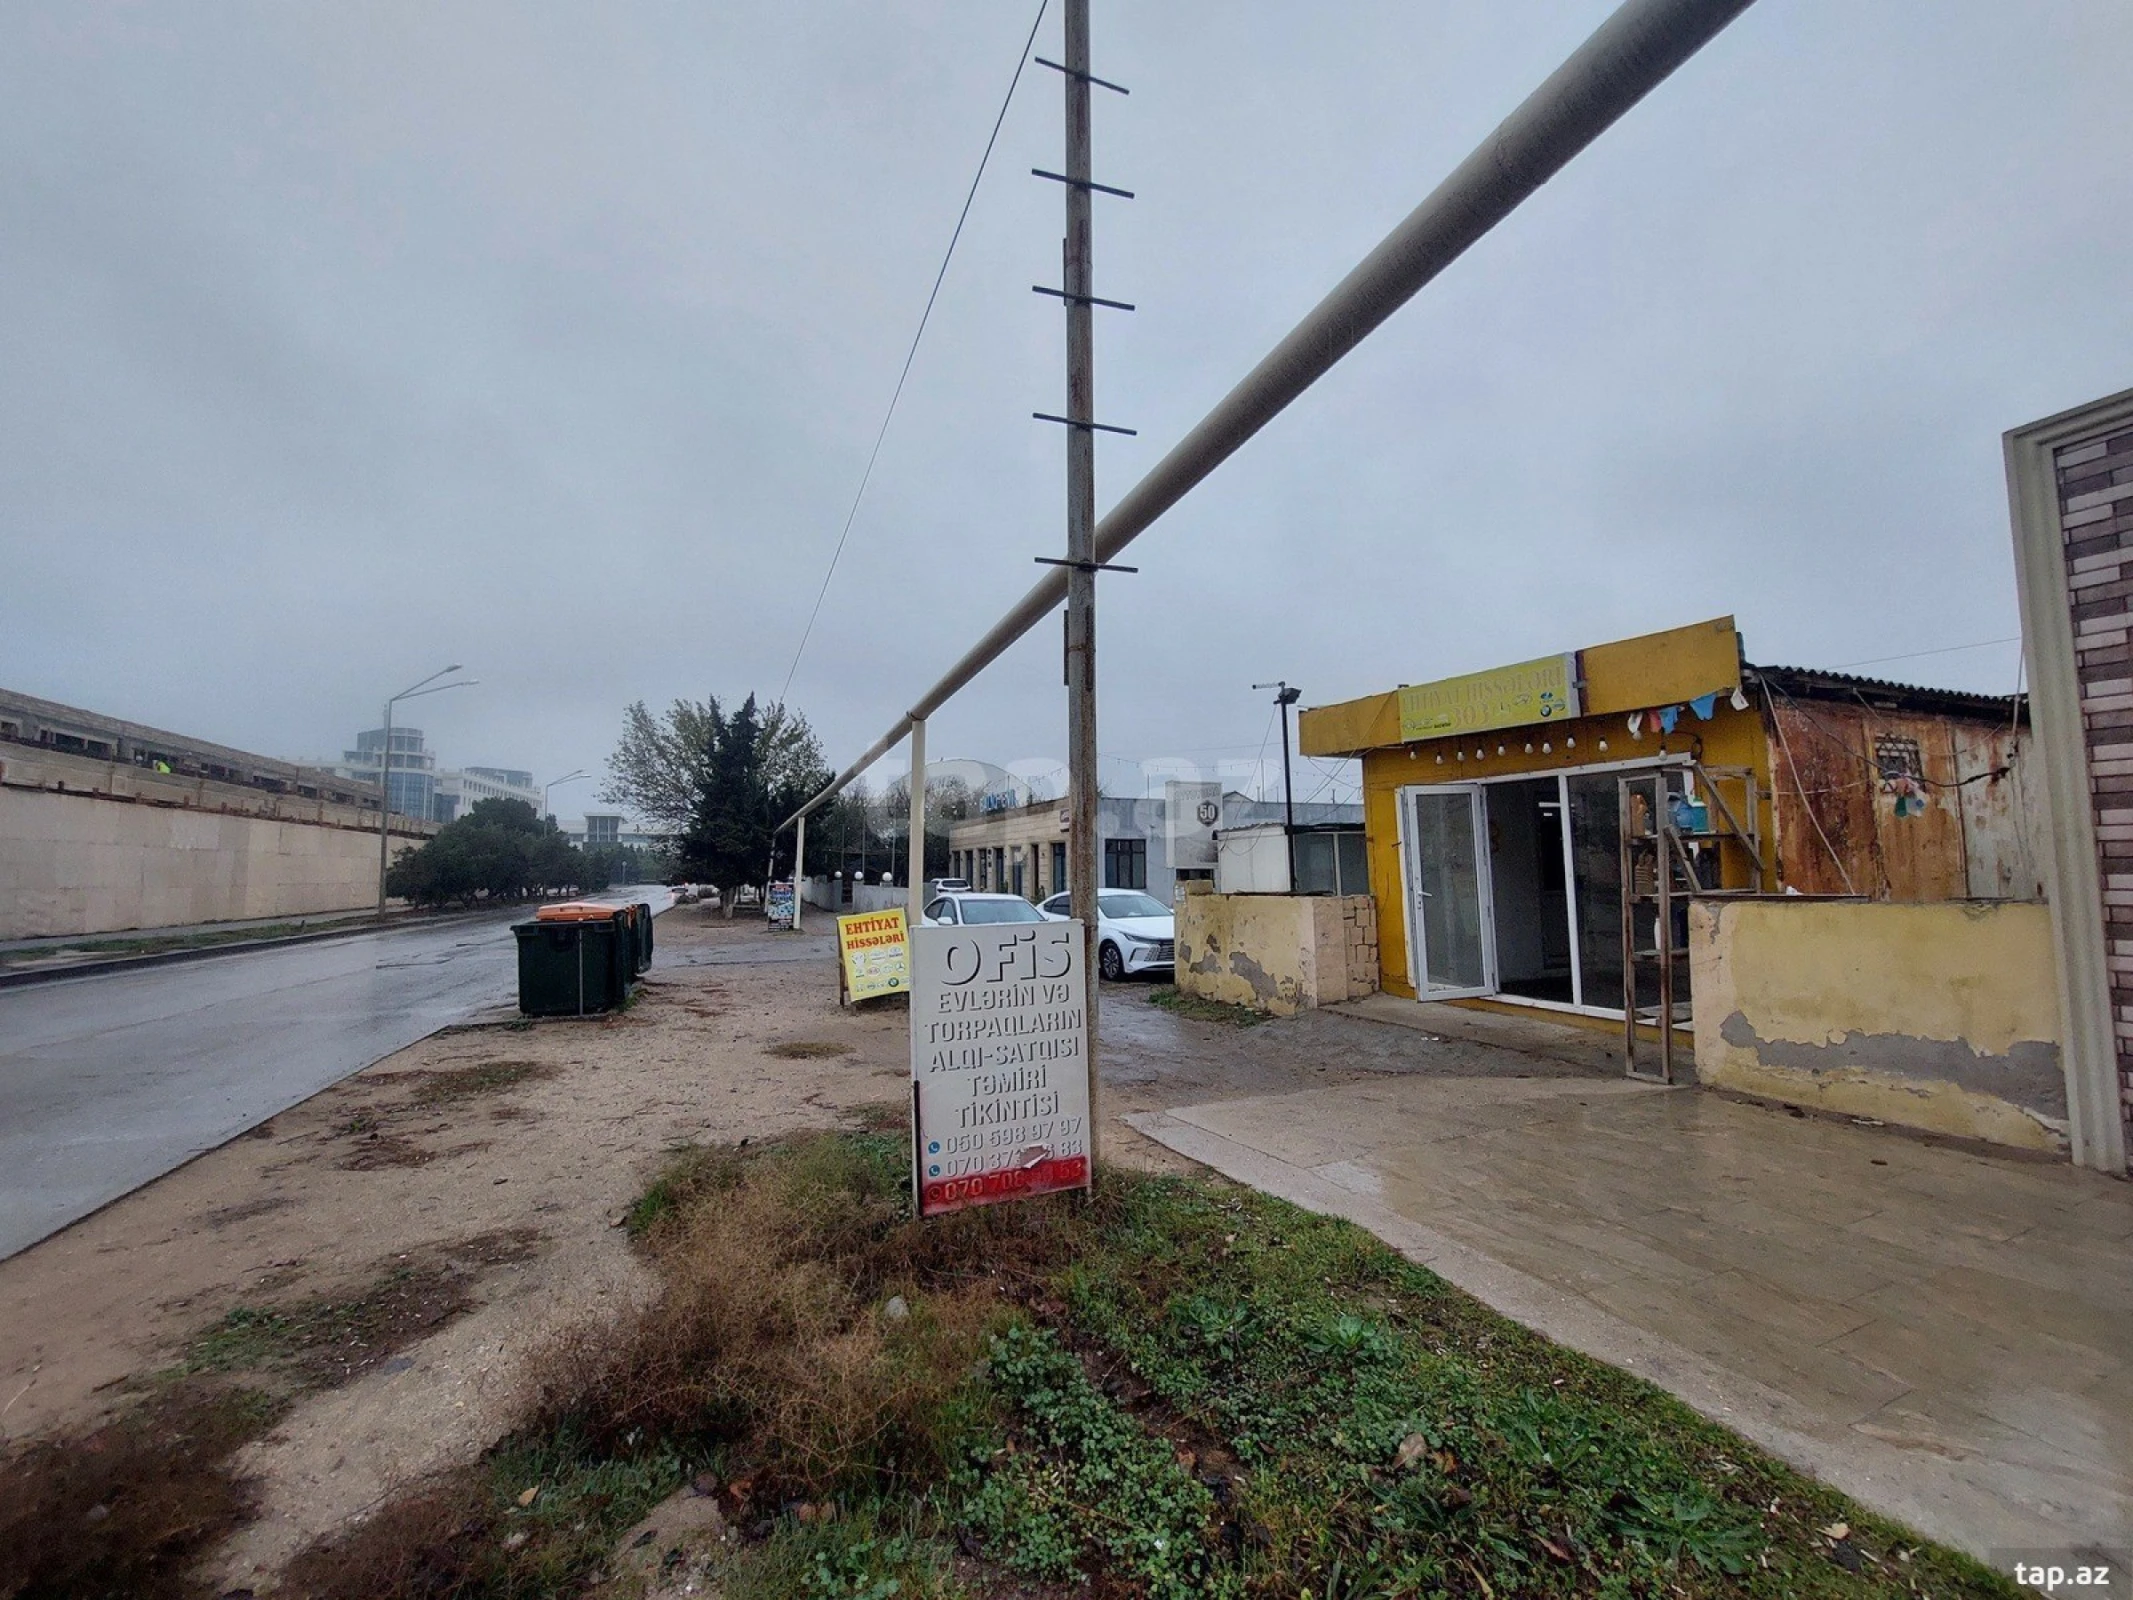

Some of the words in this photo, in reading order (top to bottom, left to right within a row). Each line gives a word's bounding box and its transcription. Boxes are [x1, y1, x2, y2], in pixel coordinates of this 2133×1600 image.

[1200, 804, 1215, 820] 50
[844, 916, 900, 936] EHTİYAT
[846, 931, 905, 950] HİSSƏLƏRİ
[938, 983, 1035, 1014] EVLƏRİN
[1043, 983, 1070, 1005] VƏ
[924, 1008, 1082, 1044] TORPAQLARIN
[929, 1036, 1080, 1073] ALQI-SATQISI
[966, 1063, 1047, 1097] TƏMİRİ
[954, 1090, 1060, 1129] TİKİNTİSİ
[946, 1132, 984, 1155] 050
[1031, 1120, 1054, 1141] 97
[1060, 1116, 1082, 1137] 97
[946, 1155, 984, 1178] 070
[944, 1177, 984, 1201] 070
